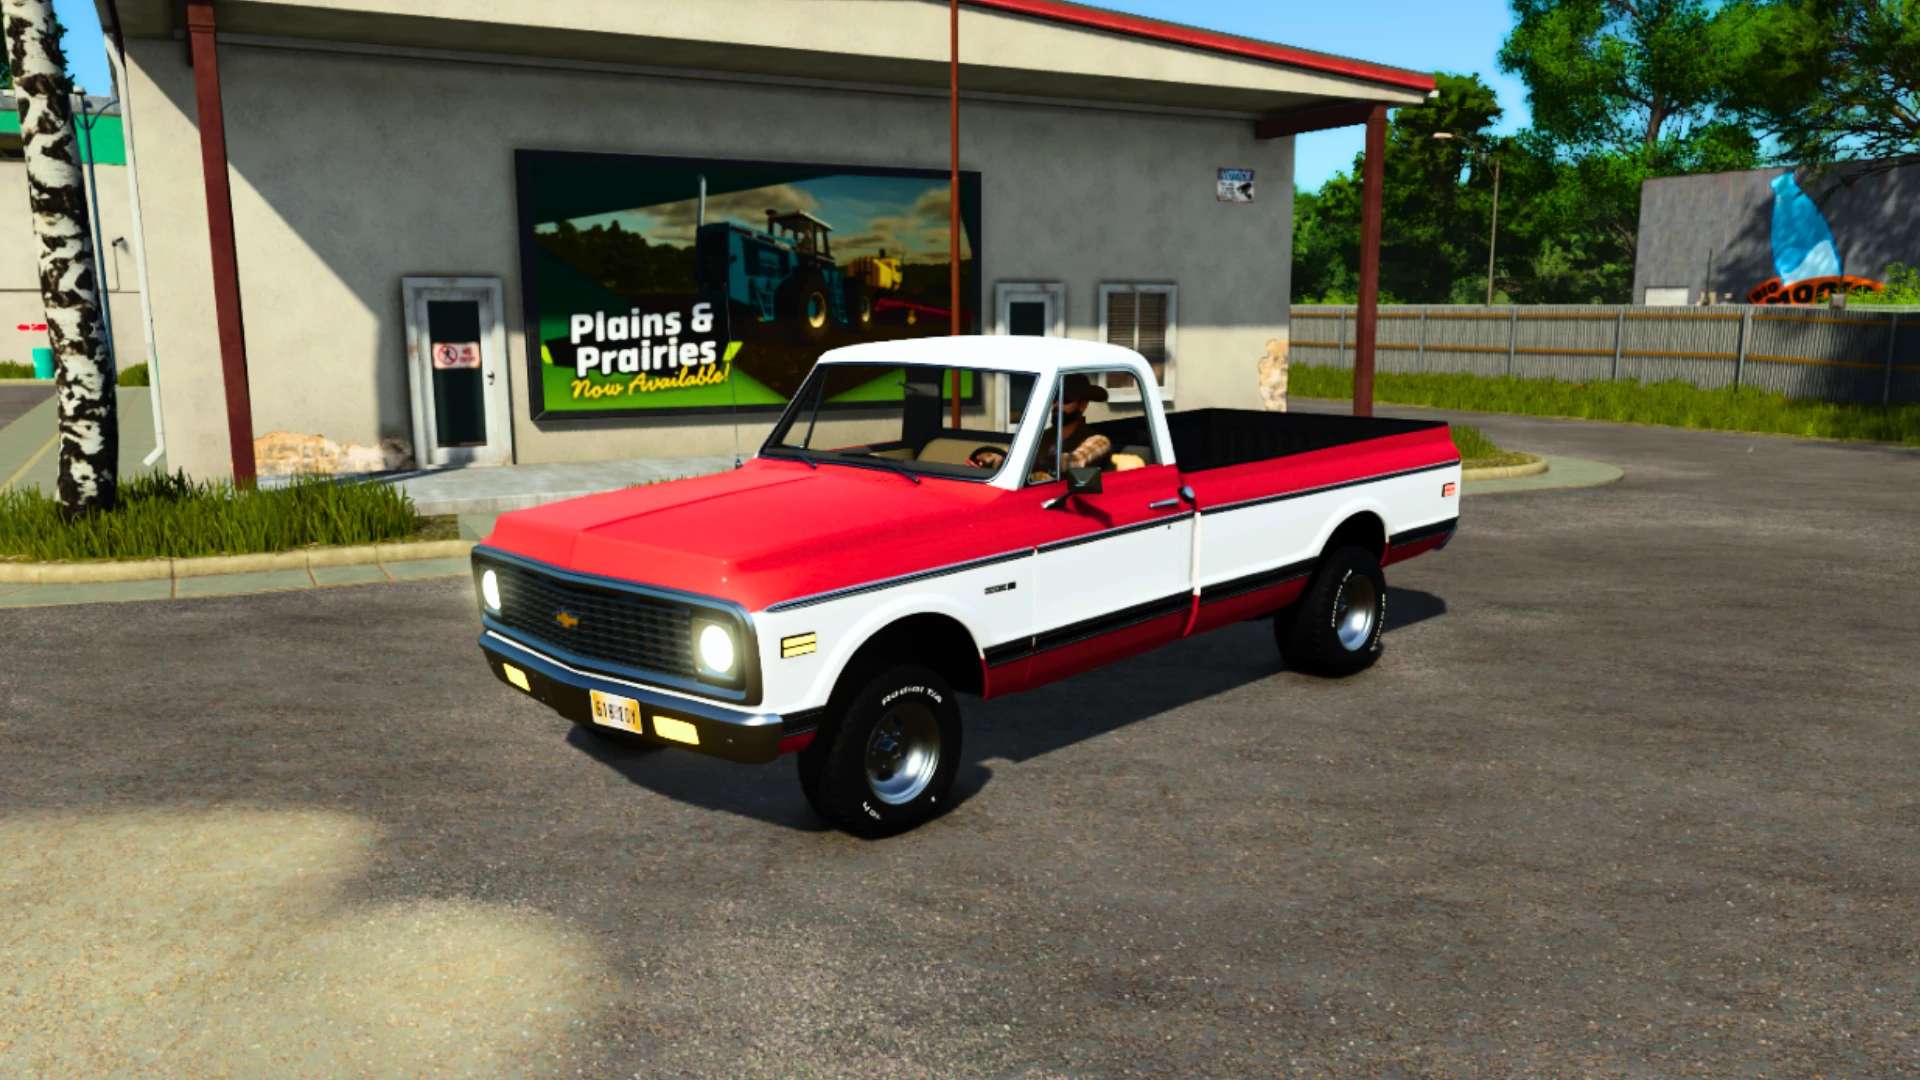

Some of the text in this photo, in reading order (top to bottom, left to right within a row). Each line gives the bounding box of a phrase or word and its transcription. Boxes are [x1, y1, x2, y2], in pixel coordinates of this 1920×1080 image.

[570, 302, 714, 345] Plains &
[576, 336, 717, 378] Prairies
[571, 363, 731, 399] Now Available!
